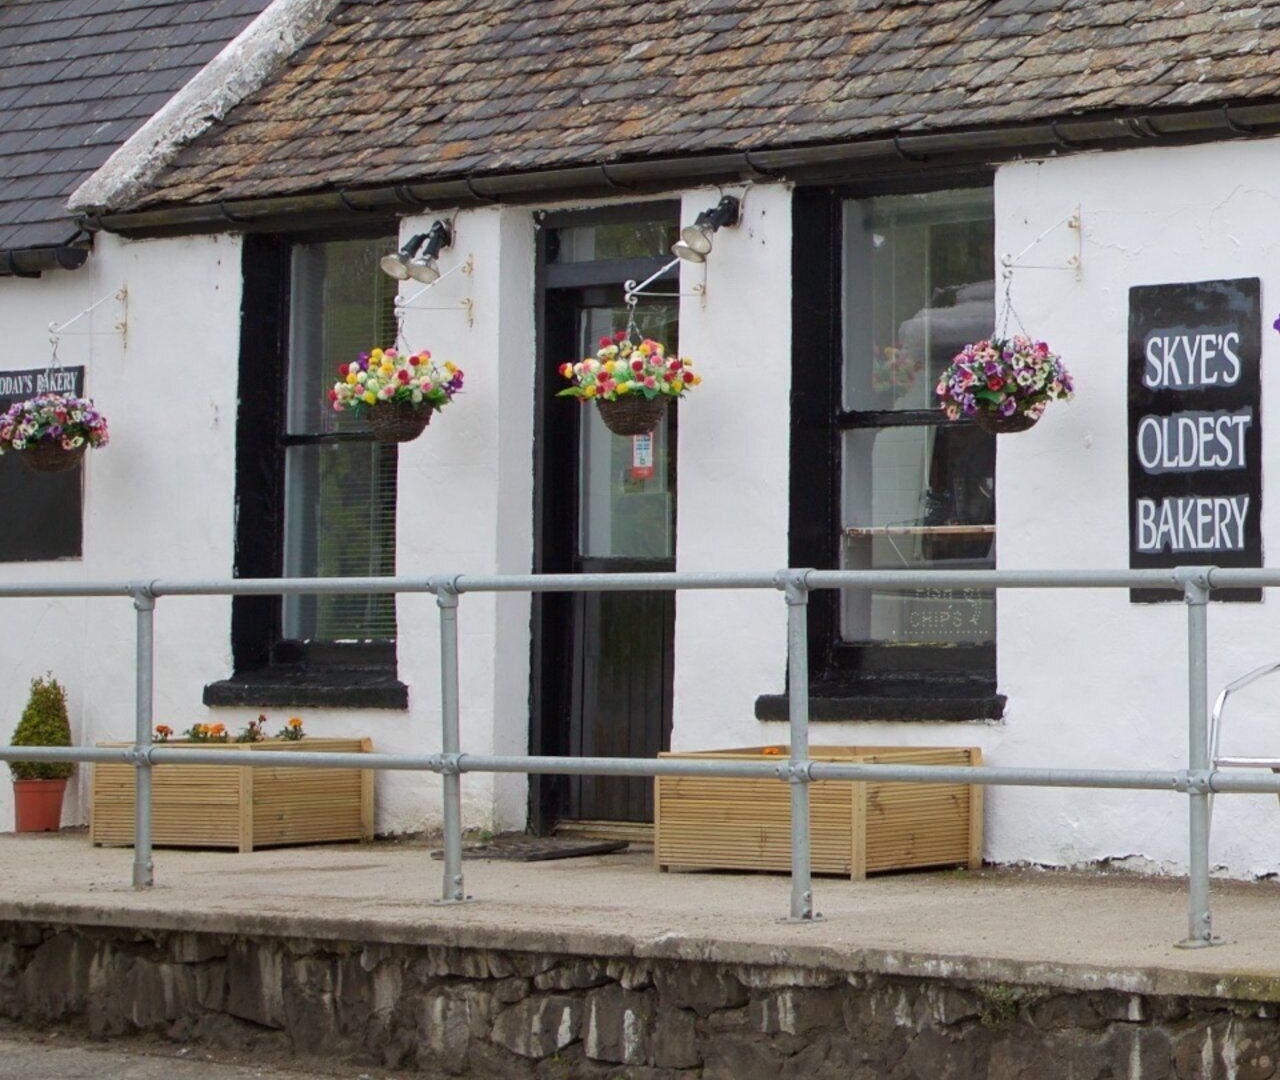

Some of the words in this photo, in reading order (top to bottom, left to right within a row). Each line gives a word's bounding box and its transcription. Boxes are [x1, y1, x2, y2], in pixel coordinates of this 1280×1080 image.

[36, 372, 78, 393] BAKERY
[1145, 331, 1240, 388] SKYE'S
[1137, 415, 1251, 468] OLDEST
[1136, 497, 1249, 549] BAKERY
